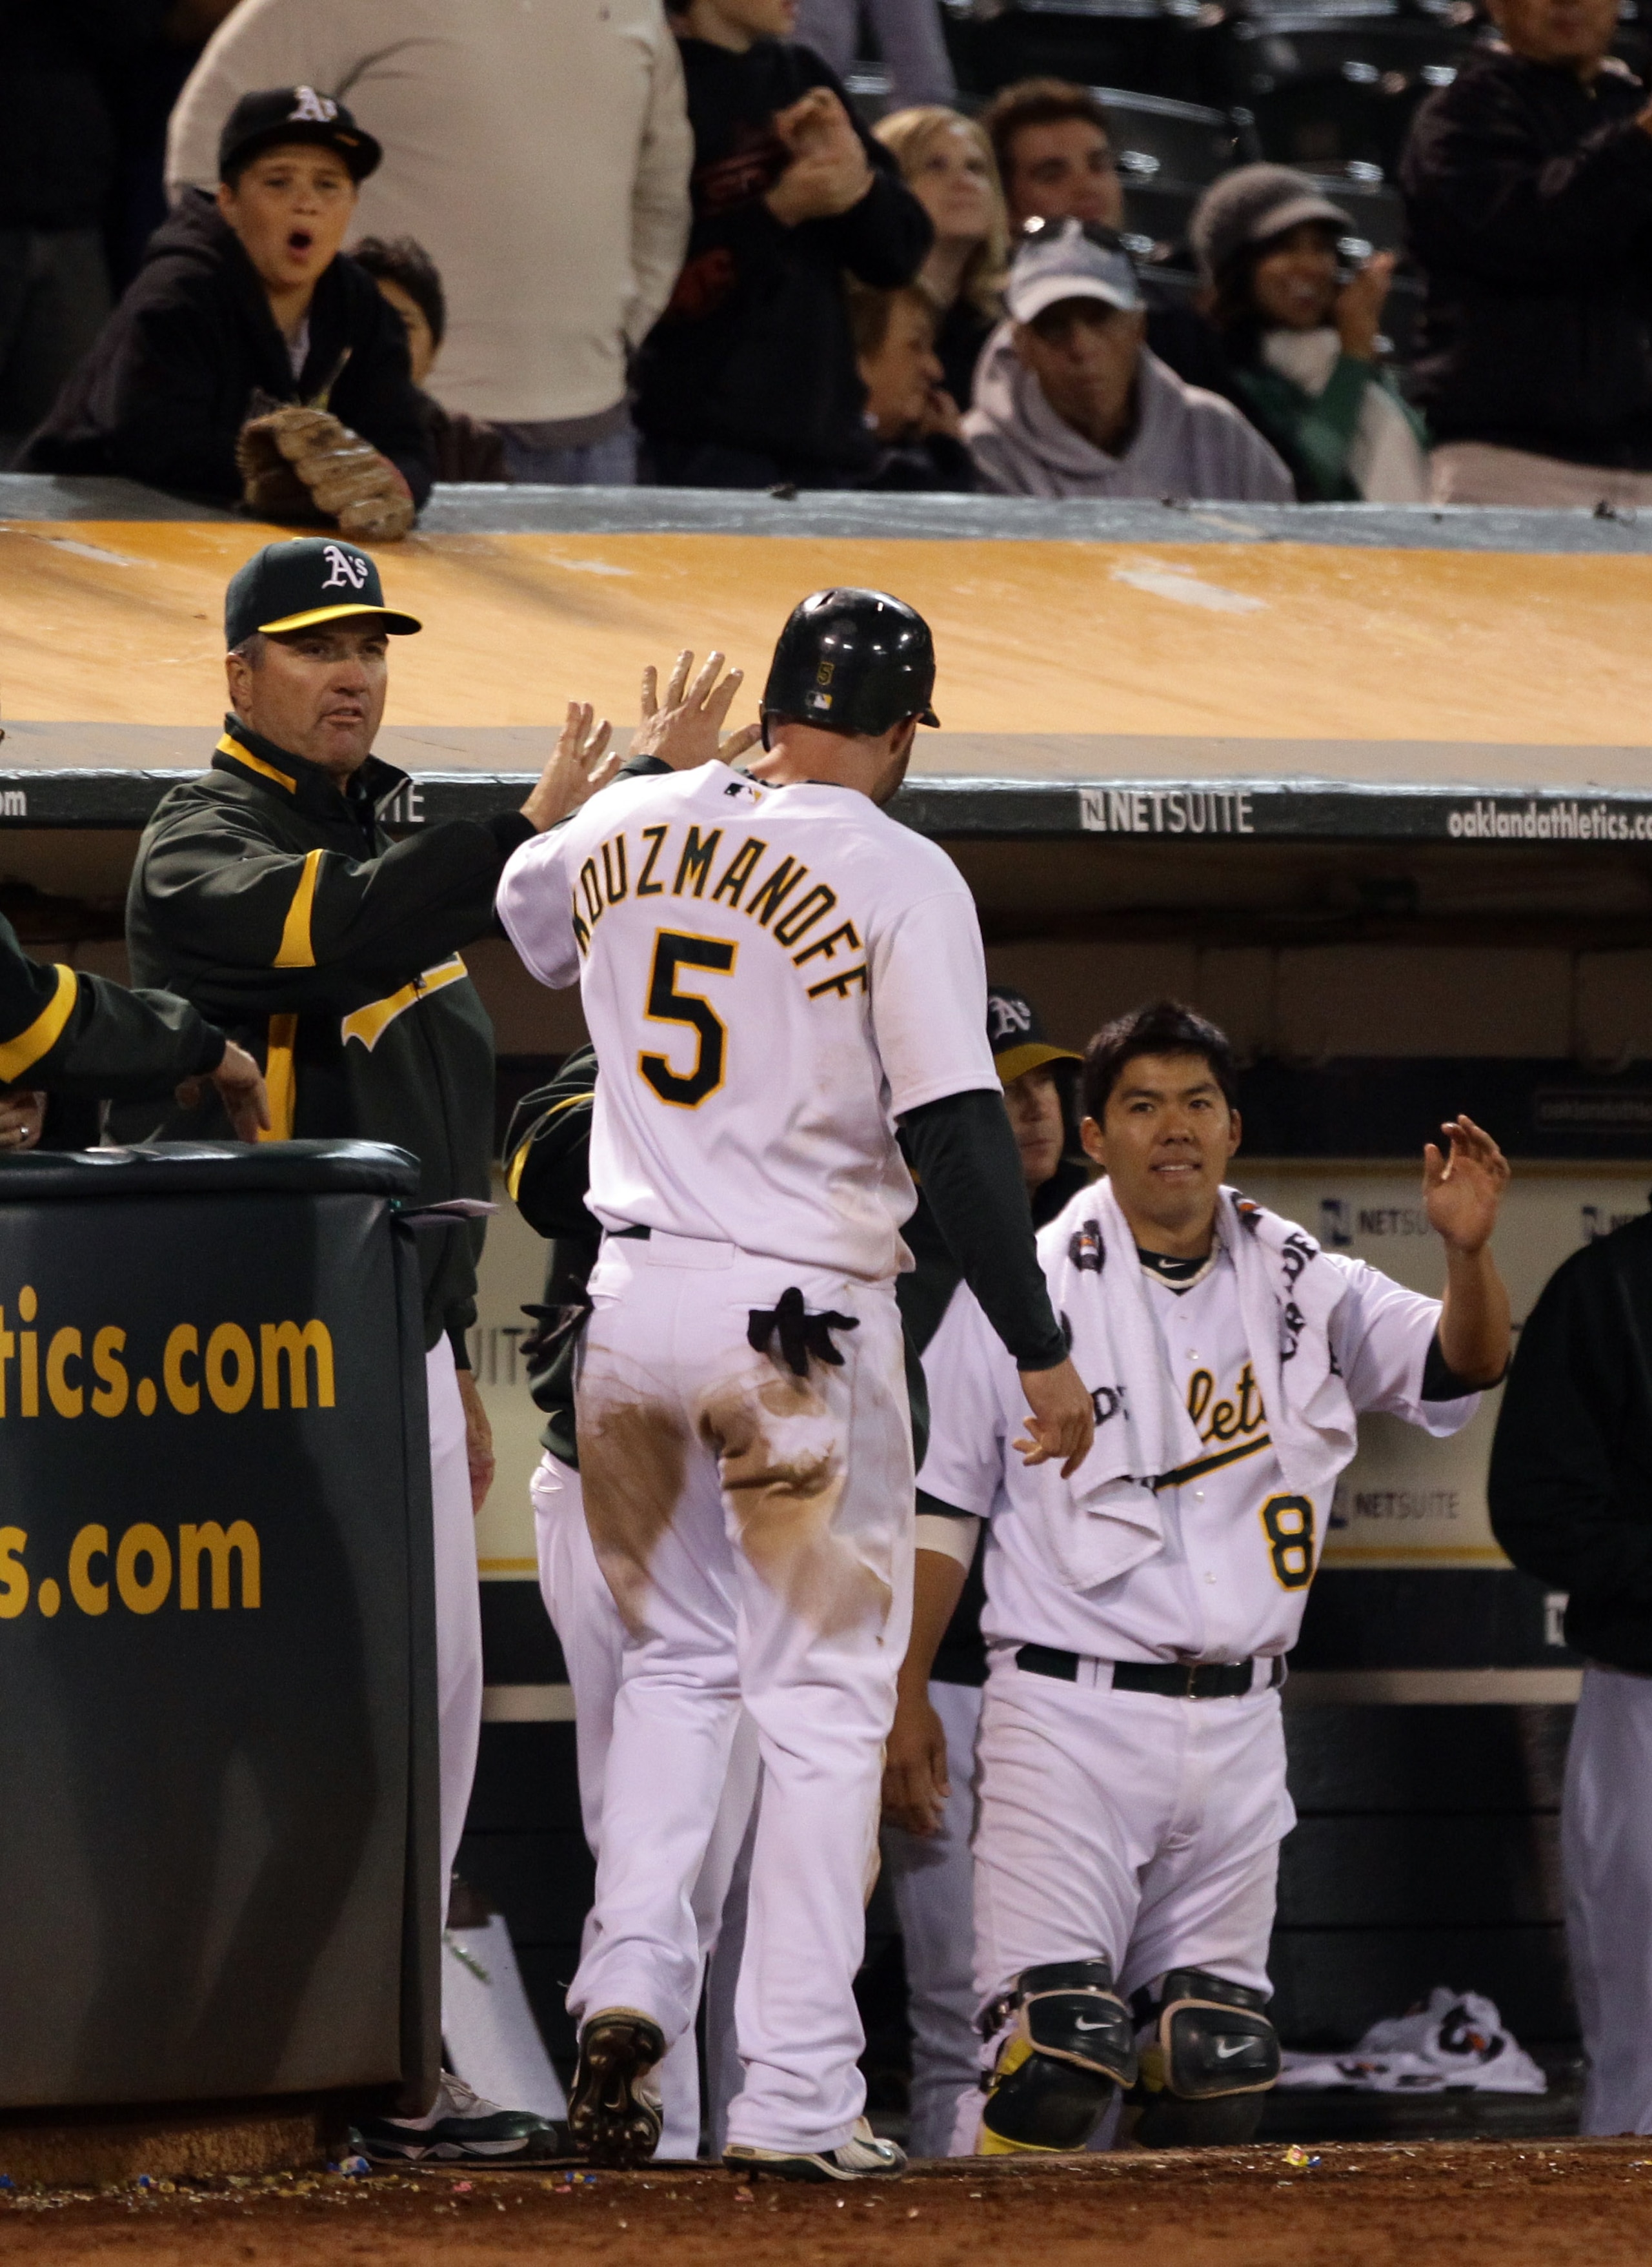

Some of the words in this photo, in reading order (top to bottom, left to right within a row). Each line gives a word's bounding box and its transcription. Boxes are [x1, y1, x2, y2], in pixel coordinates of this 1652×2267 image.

[321, 545, 368, 589] A's
[816, 662, 834, 686] 5
[1109, 791, 1256, 833] NETSUITE
[638, 927, 740, 1112] 5
[0, 1520, 261, 1619] s.com
[1258, 1492, 1316, 1593] 8
